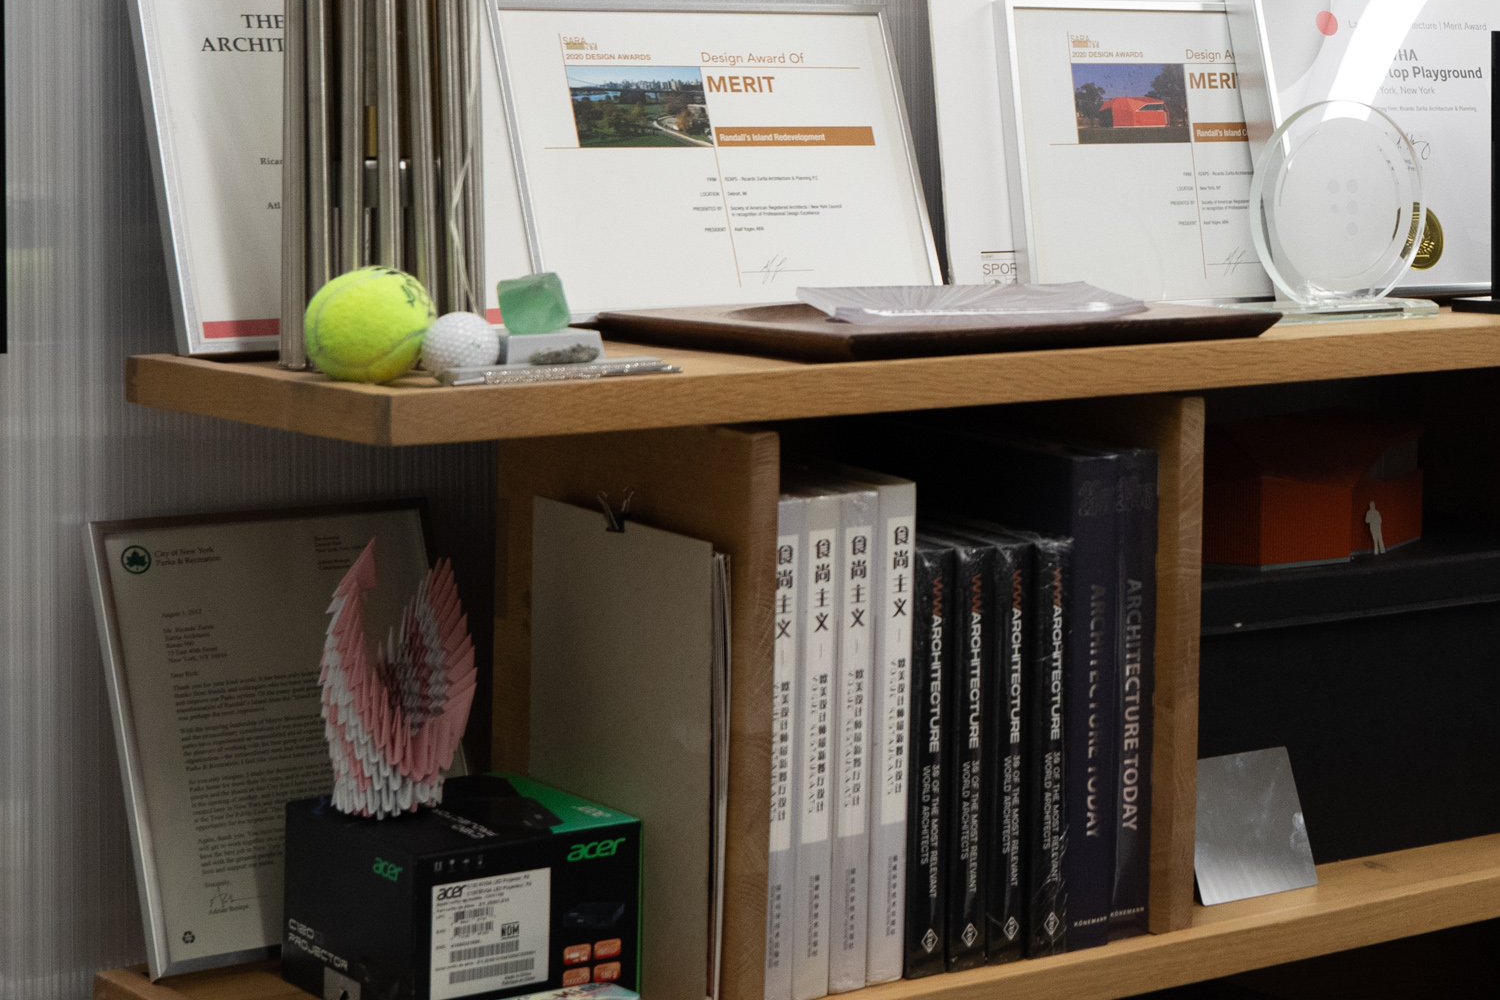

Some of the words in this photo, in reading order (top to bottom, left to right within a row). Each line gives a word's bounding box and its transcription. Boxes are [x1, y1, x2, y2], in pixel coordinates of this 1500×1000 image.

[241, 14, 283, 29] THE
[1443, 22, 1462, 31] Merit
[1464, 22, 1487, 31] Award
[563, 36, 586, 45] SARA
[1070, 34, 1090, 42] SARA
[585, 53, 615, 61] DESIGN
[617, 53, 651, 61] AWARDS
[700, 52, 743, 66] Design
[747, 53, 786, 63] Award
[789, 53, 804, 63] Of
[1185, 49, 1221, 62] Design
[1188, 72, 1239, 89] MERI
[1412, 65, 1483, 82] Playground
[706, 75, 775, 93] MERIT
[1380, 86, 1398, 96] York,
[1400, 86, 1417, 95] New
[1418, 86, 1436, 95] York
[719, 132, 751, 142] Randall's
[752, 133, 773, 142] Island
[774, 133, 826, 142] Redevelopment
[1196, 129, 1223, 137] Randall's
[1224, 129, 1242, 137] Island
[154, 550, 169, 558] City
[198, 547, 214, 555] York
[156, 558, 176, 566] Parks
[185, 555, 221, 565] Recreation
[893, 526, 910, 618] 食尚主义
[814, 538, 831, 632] 食尚主义
[850, 535, 867, 629] 食尚主义
[1123, 578, 1142, 751] ARCHITECTURE
[1122, 755, 1139, 830] TODAY
[1002, 795, 1011, 854] ARCHITECTS
[920, 805, 930, 866] ARCHITECTS
[566, 836, 626, 863] acer
[372, 856, 403, 883] acer
[1010, 839, 1019, 886] RELEVANT
[929, 849, 938, 899] RELEVANT
[436, 884, 467, 901] acer
[501, 924, 520, 938] NOM
[288, 932, 348, 972] PROJECTOR
